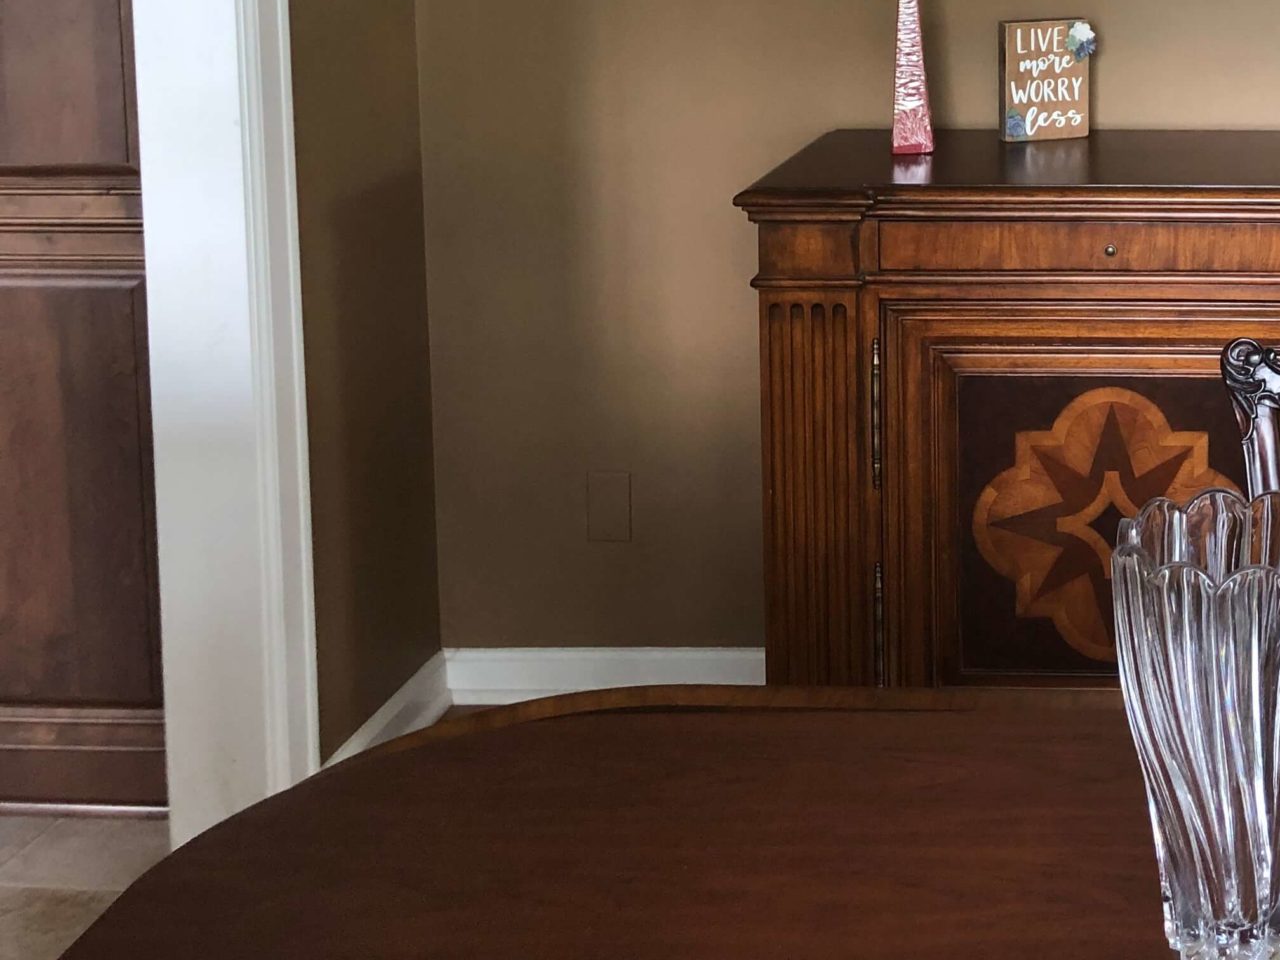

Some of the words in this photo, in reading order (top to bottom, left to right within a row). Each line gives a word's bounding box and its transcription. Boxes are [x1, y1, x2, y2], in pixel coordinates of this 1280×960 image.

[1016, 26, 1064, 54] LIVE
[1019, 53, 1074, 78] more
[1010, 76, 1083, 105] WORRY
[1025, 106, 1085, 136] less
